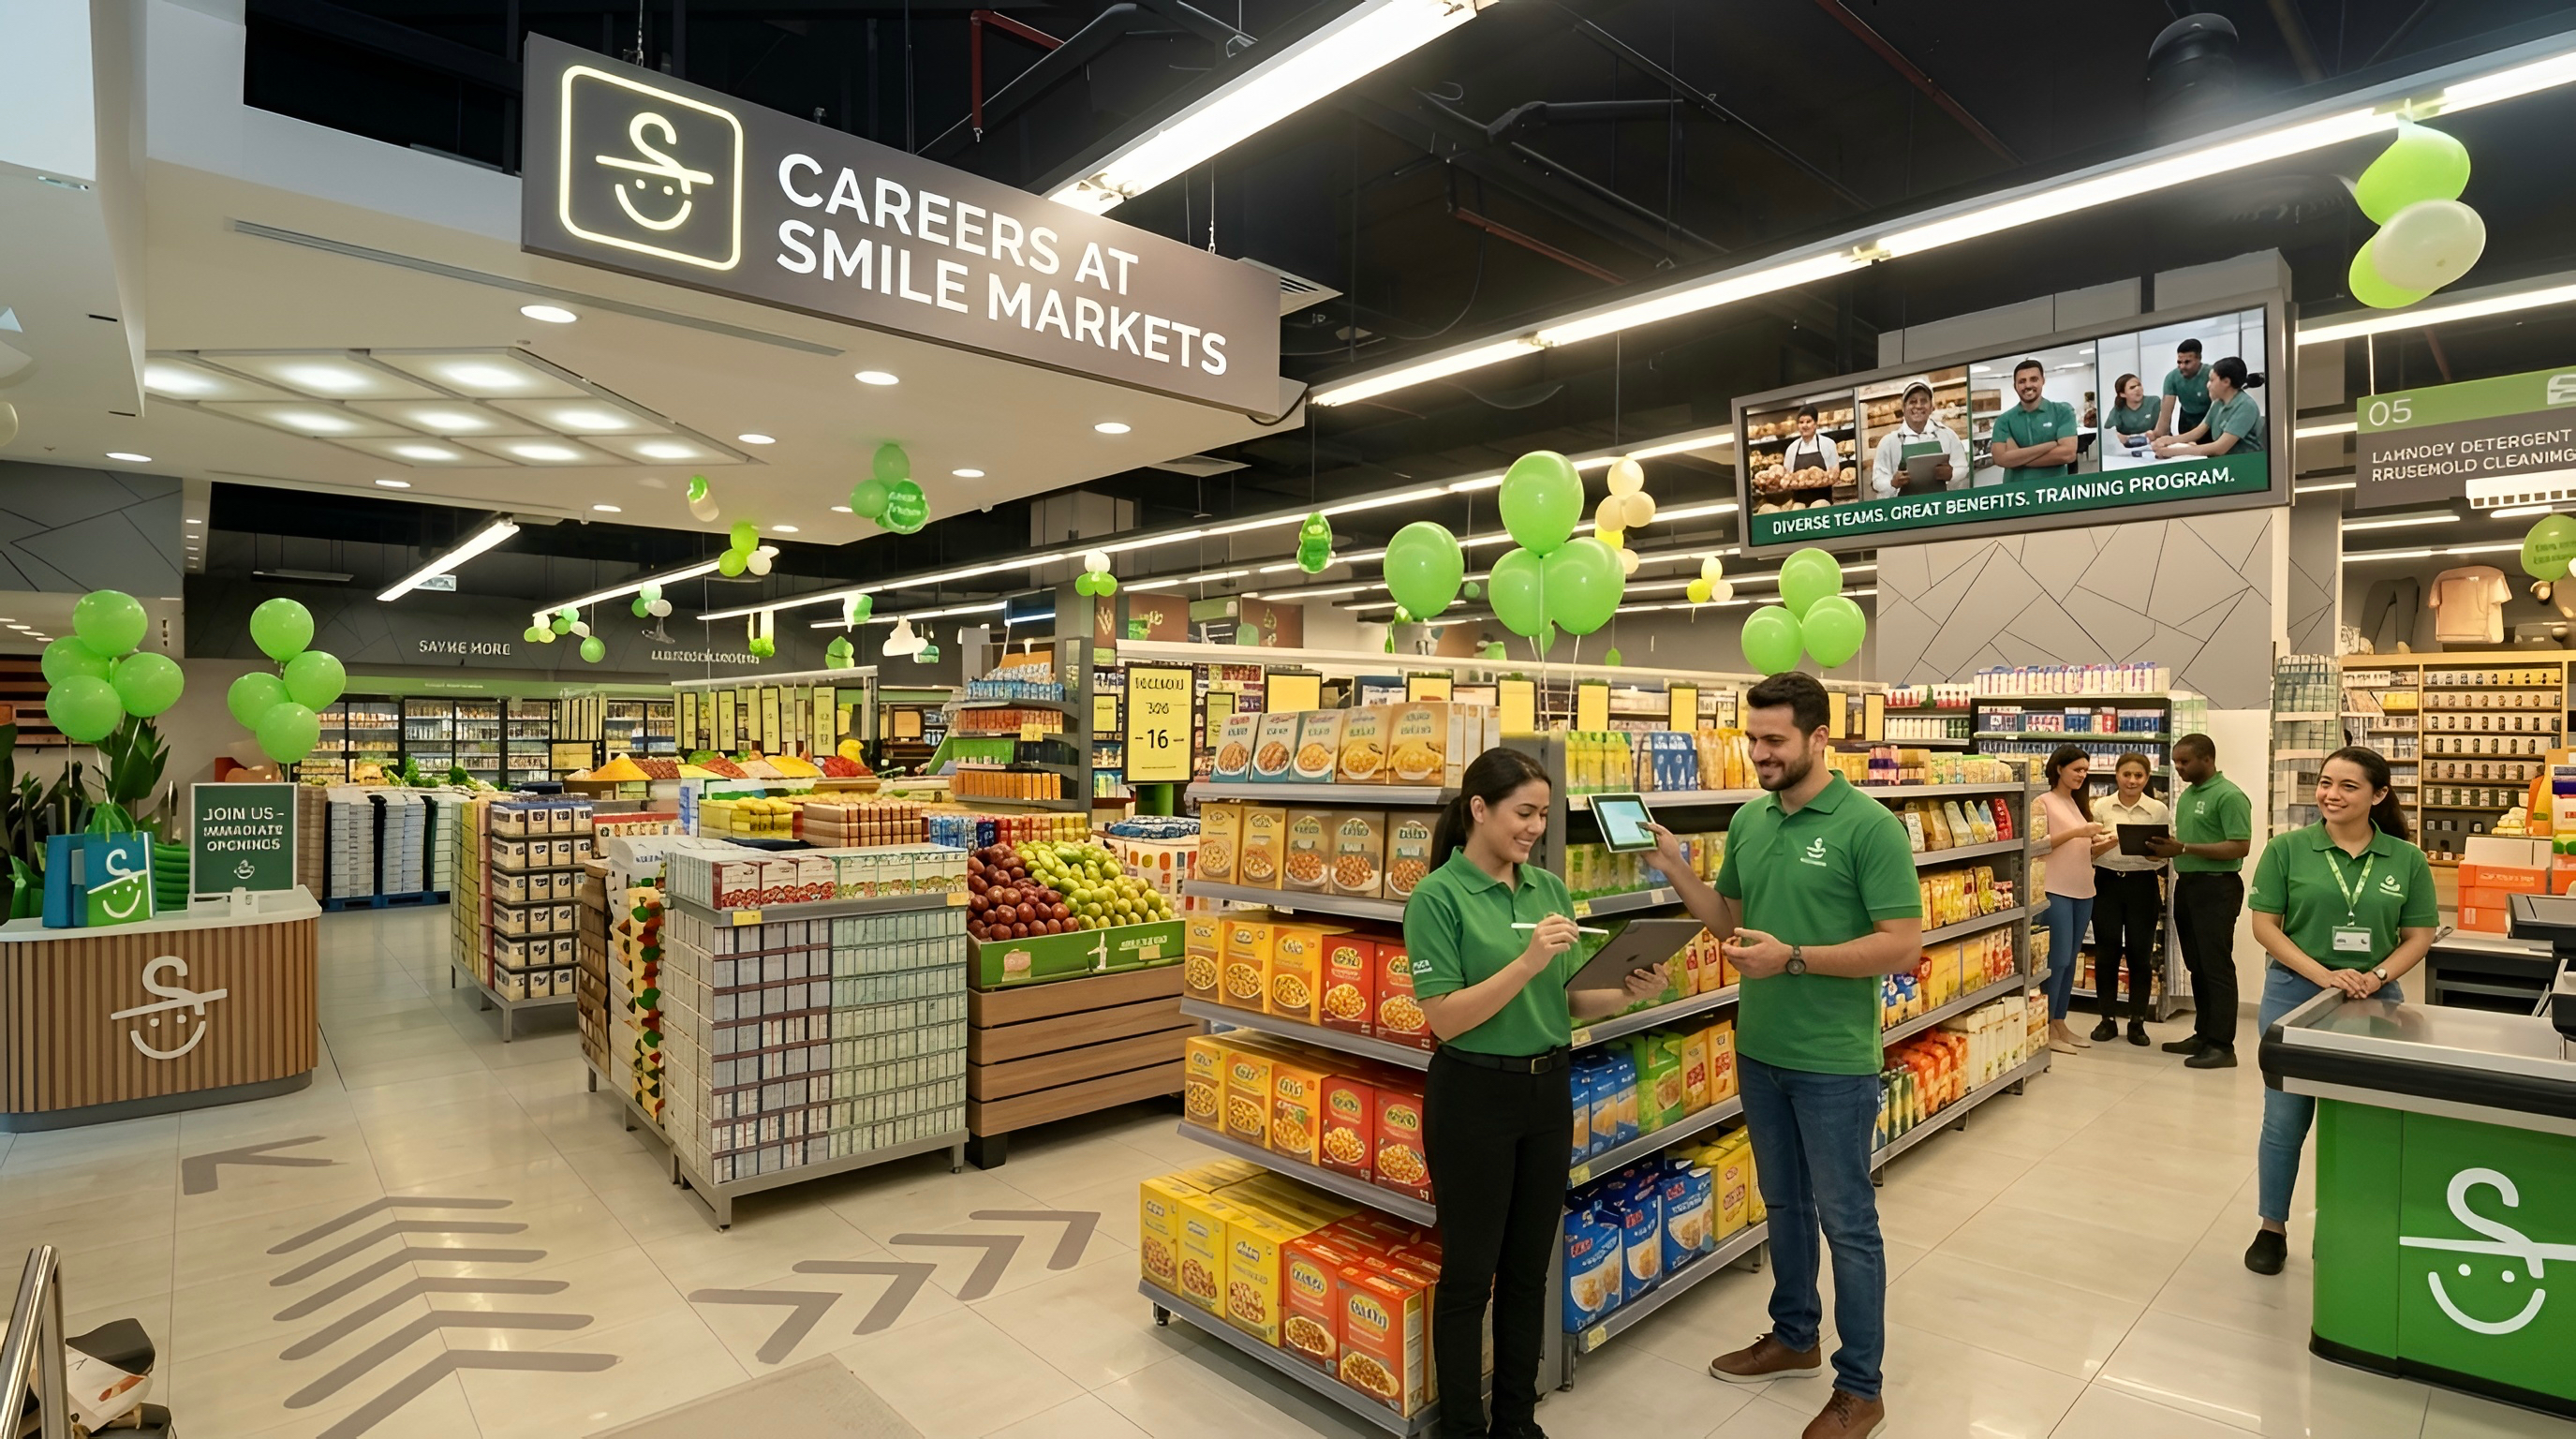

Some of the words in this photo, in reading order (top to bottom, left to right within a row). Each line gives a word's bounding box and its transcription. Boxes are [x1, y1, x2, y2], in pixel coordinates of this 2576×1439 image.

[777, 153, 1060, 275] CAREERS
[1073, 242, 1139, 296] AT
[776, 218, 970, 314] SMILE
[987, 272, 1228, 377] MARKETS
[2368, 398, 2412, 426] 05
[2460, 428, 2572, 454] DETERGENT
[1772, 516, 1831, 535] DIVERSE
[1833, 508, 1888, 527] TEAMS.
[1890, 501, 1942, 521] GREAT
[1946, 491, 2031, 515] BENEFITS.
[2035, 480, 2124, 504] TRAINING
[2128, 467, 2236, 494] PROGRAM.
[202, 808, 245, 821] JOIN
[251, 808, 274, 820] US
